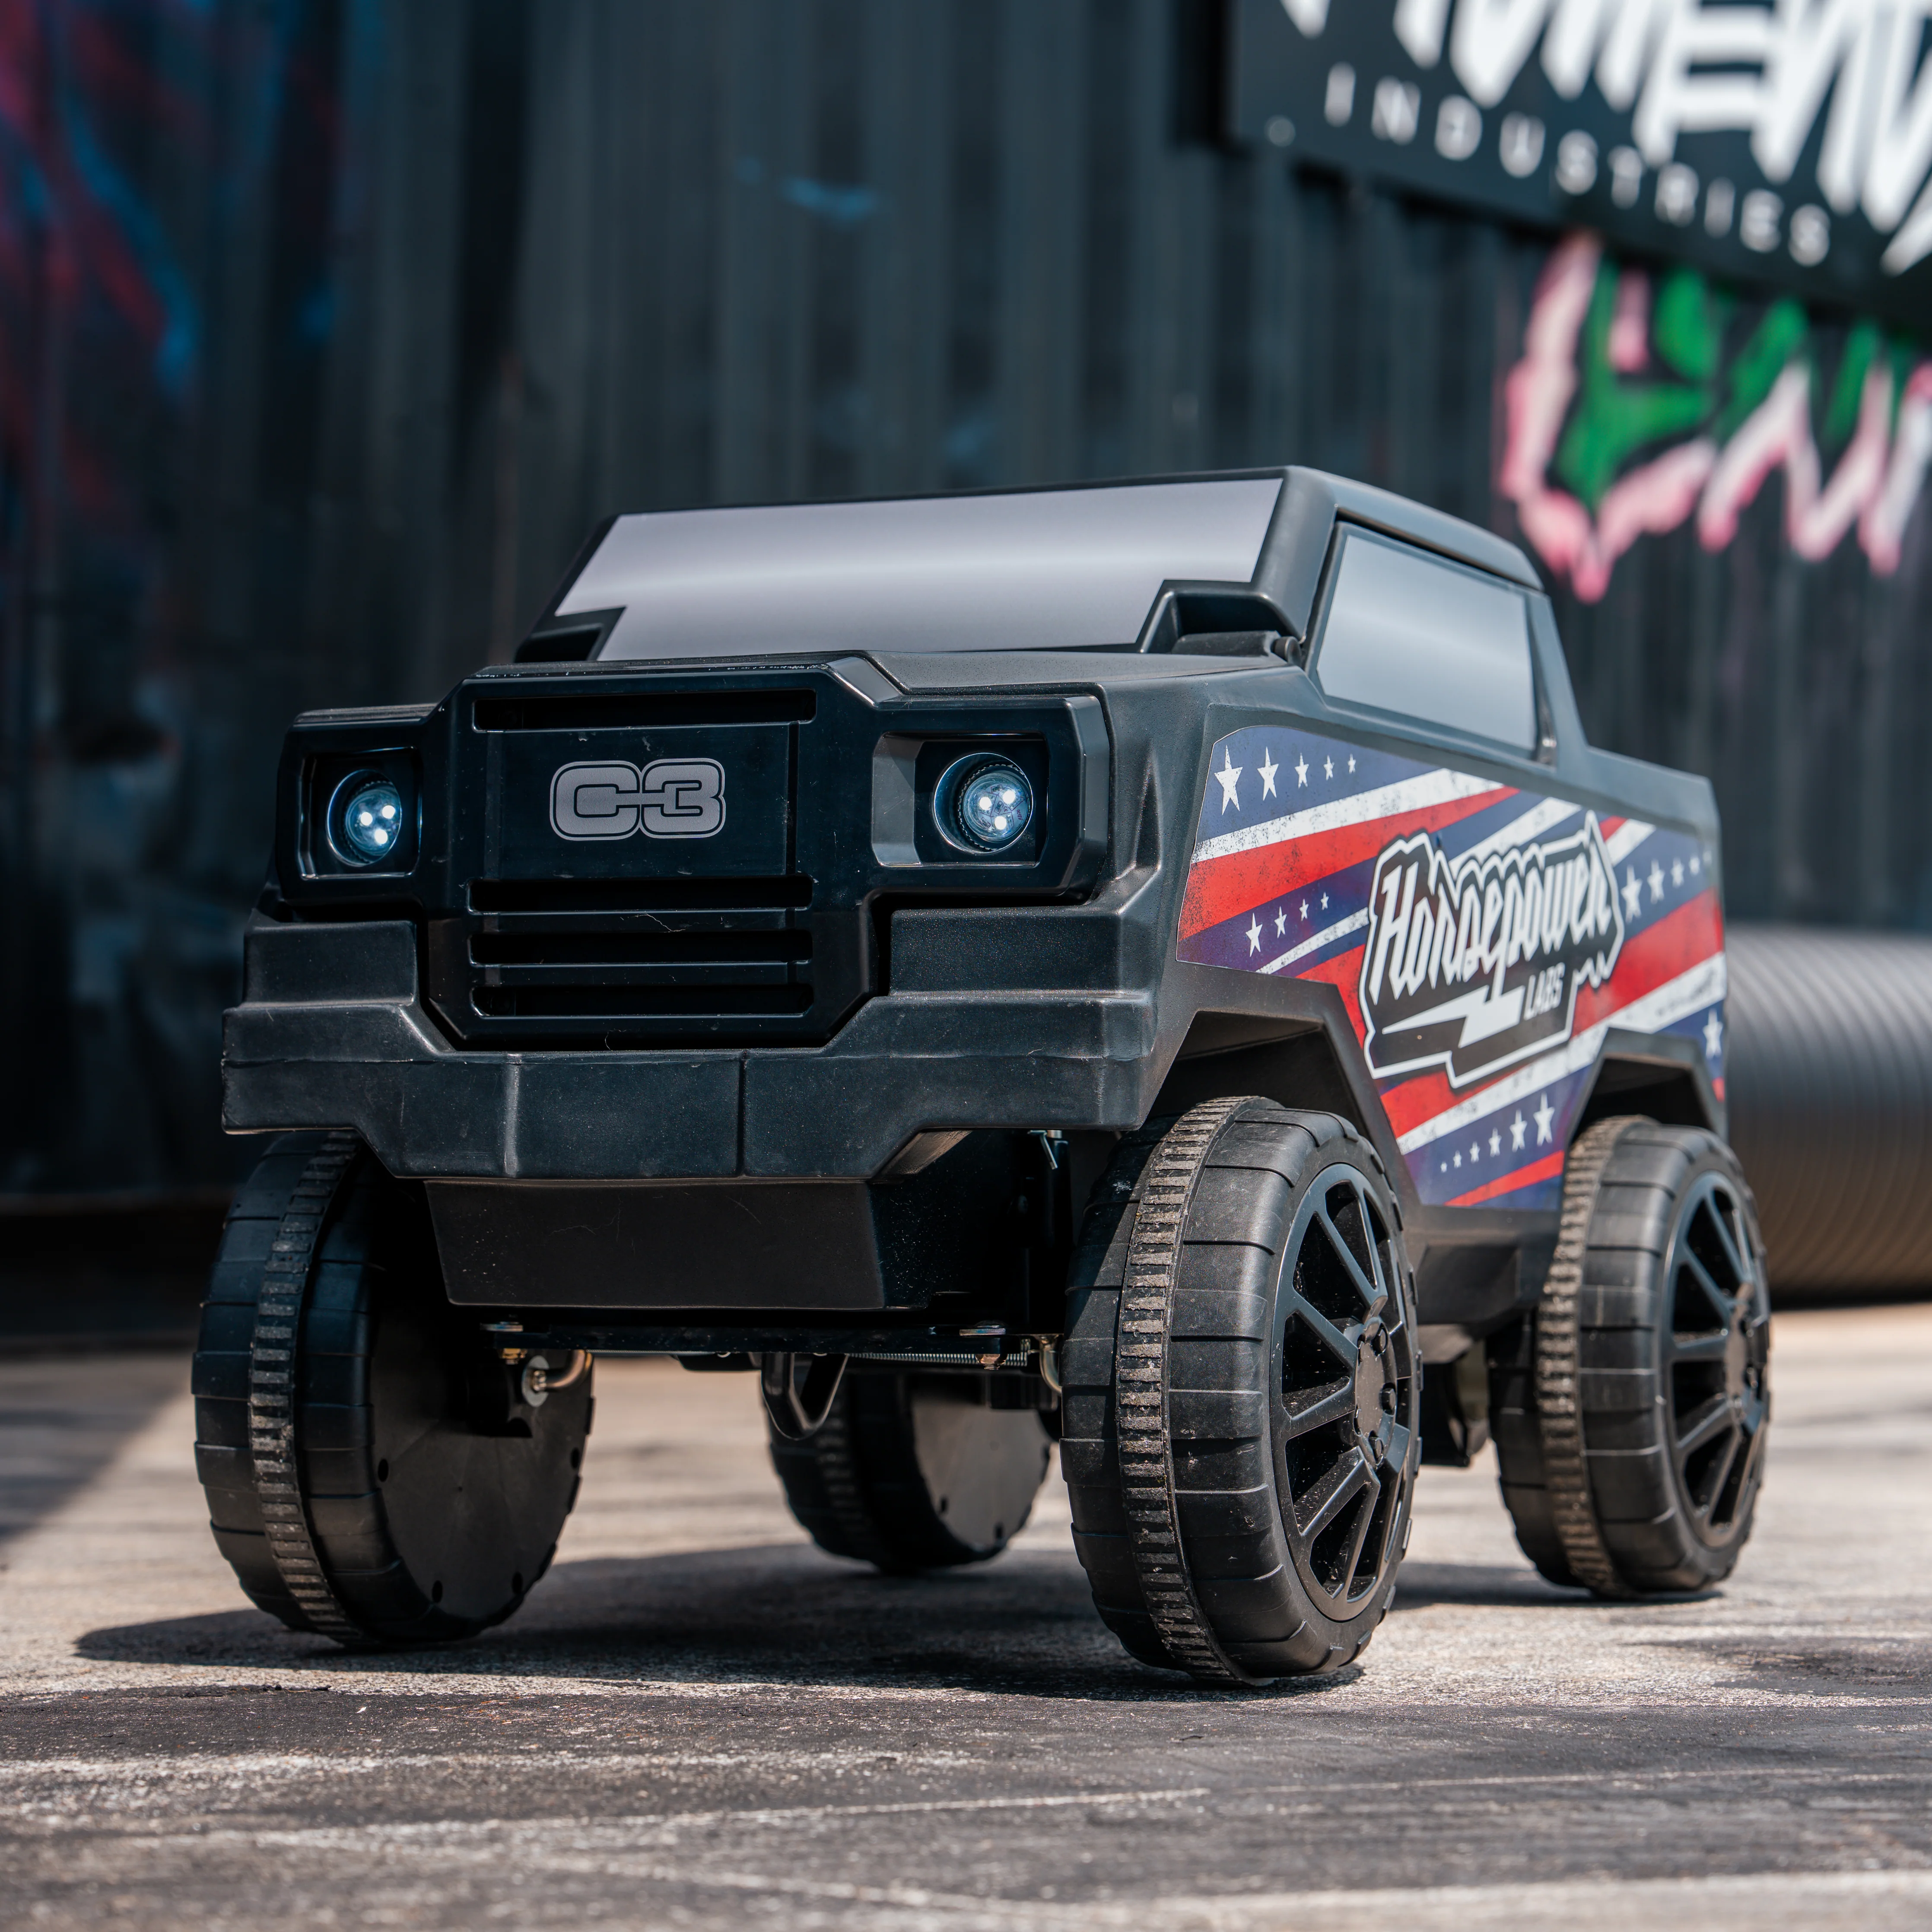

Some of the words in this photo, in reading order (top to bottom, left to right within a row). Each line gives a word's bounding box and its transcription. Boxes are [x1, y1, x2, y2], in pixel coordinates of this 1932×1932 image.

[1324, 61, 1831, 266] INDUSTRIES
[1369, 840, 1612, 1005] Horsepower
[1523, 962, 1566, 1021] LABS
